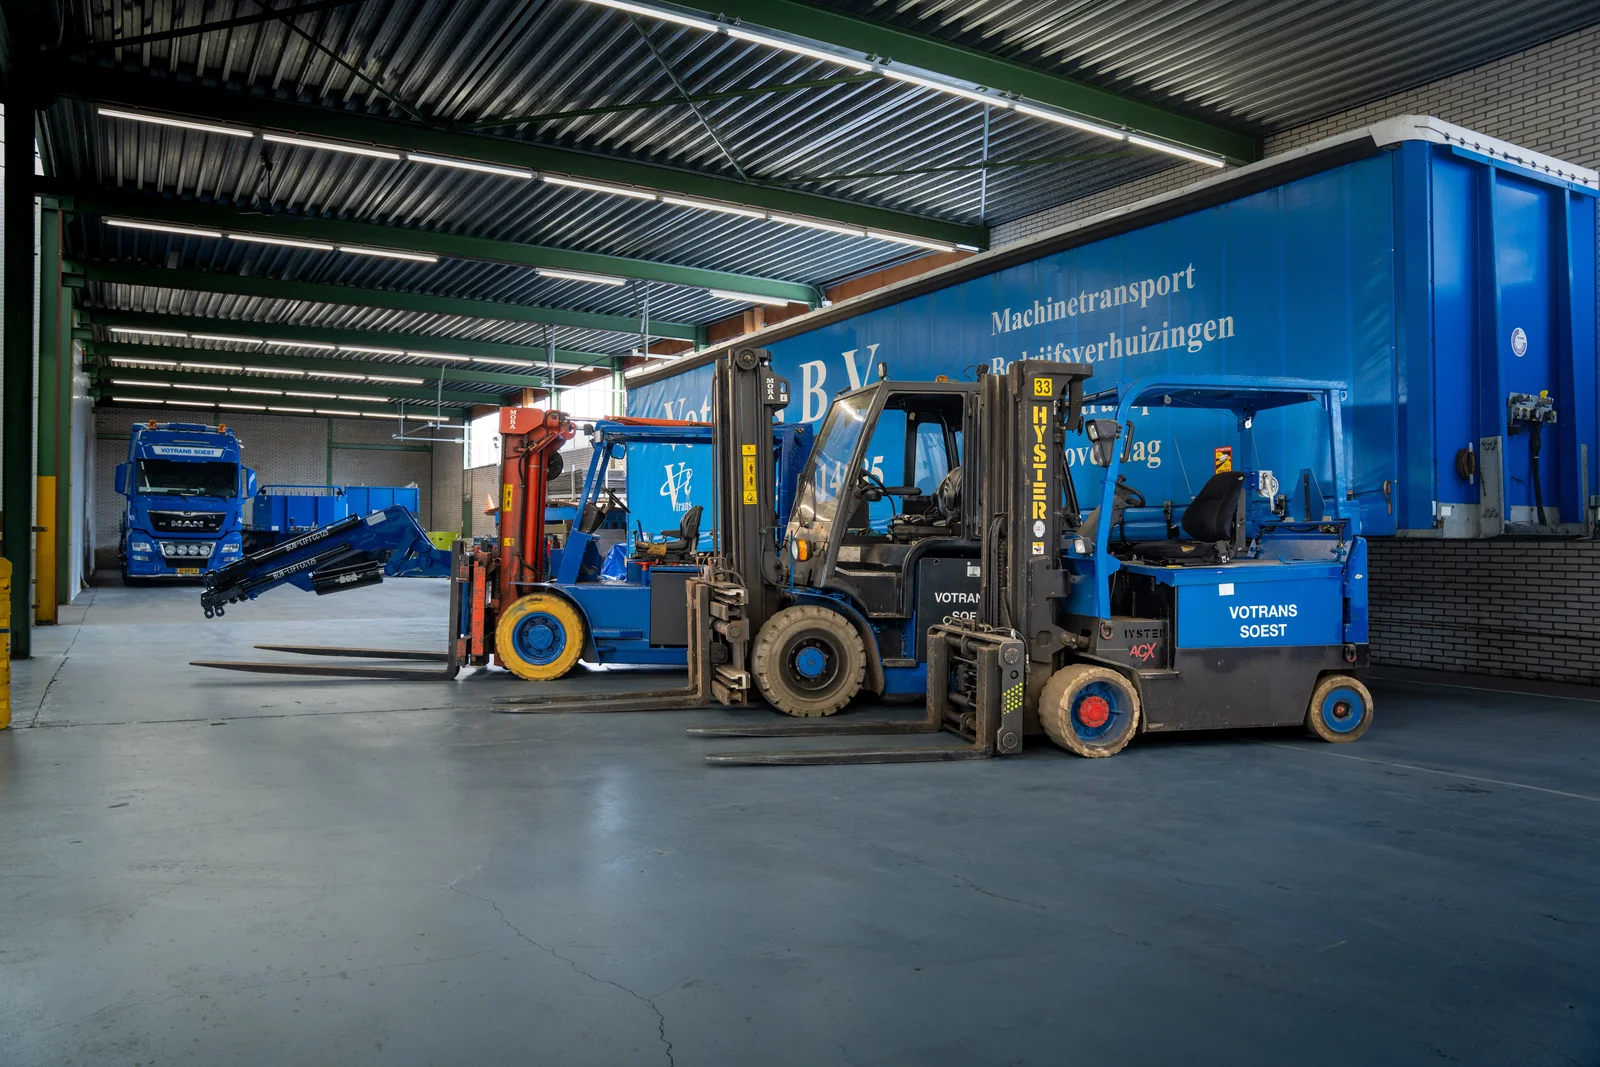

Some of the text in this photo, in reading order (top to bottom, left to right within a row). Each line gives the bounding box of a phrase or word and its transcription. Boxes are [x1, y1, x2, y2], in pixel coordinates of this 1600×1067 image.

[991, 262, 1196, 336] Machinetransport
[766, 378, 775, 400] MORA
[1035, 379, 1051, 394] 33
[509, 409, 517, 430] MORA
[160, 447, 216, 456] VOTRANS SOEST
[1032, 406, 1047, 520] HYSTER
[171, 519, 204, 528] MAN
[934, 592, 981, 603] VOTRAN
[1229, 604, 1298, 619] VOTRANS
[1239, 623, 1287, 638] SOEST
[1129, 641, 1157, 662] ACX
